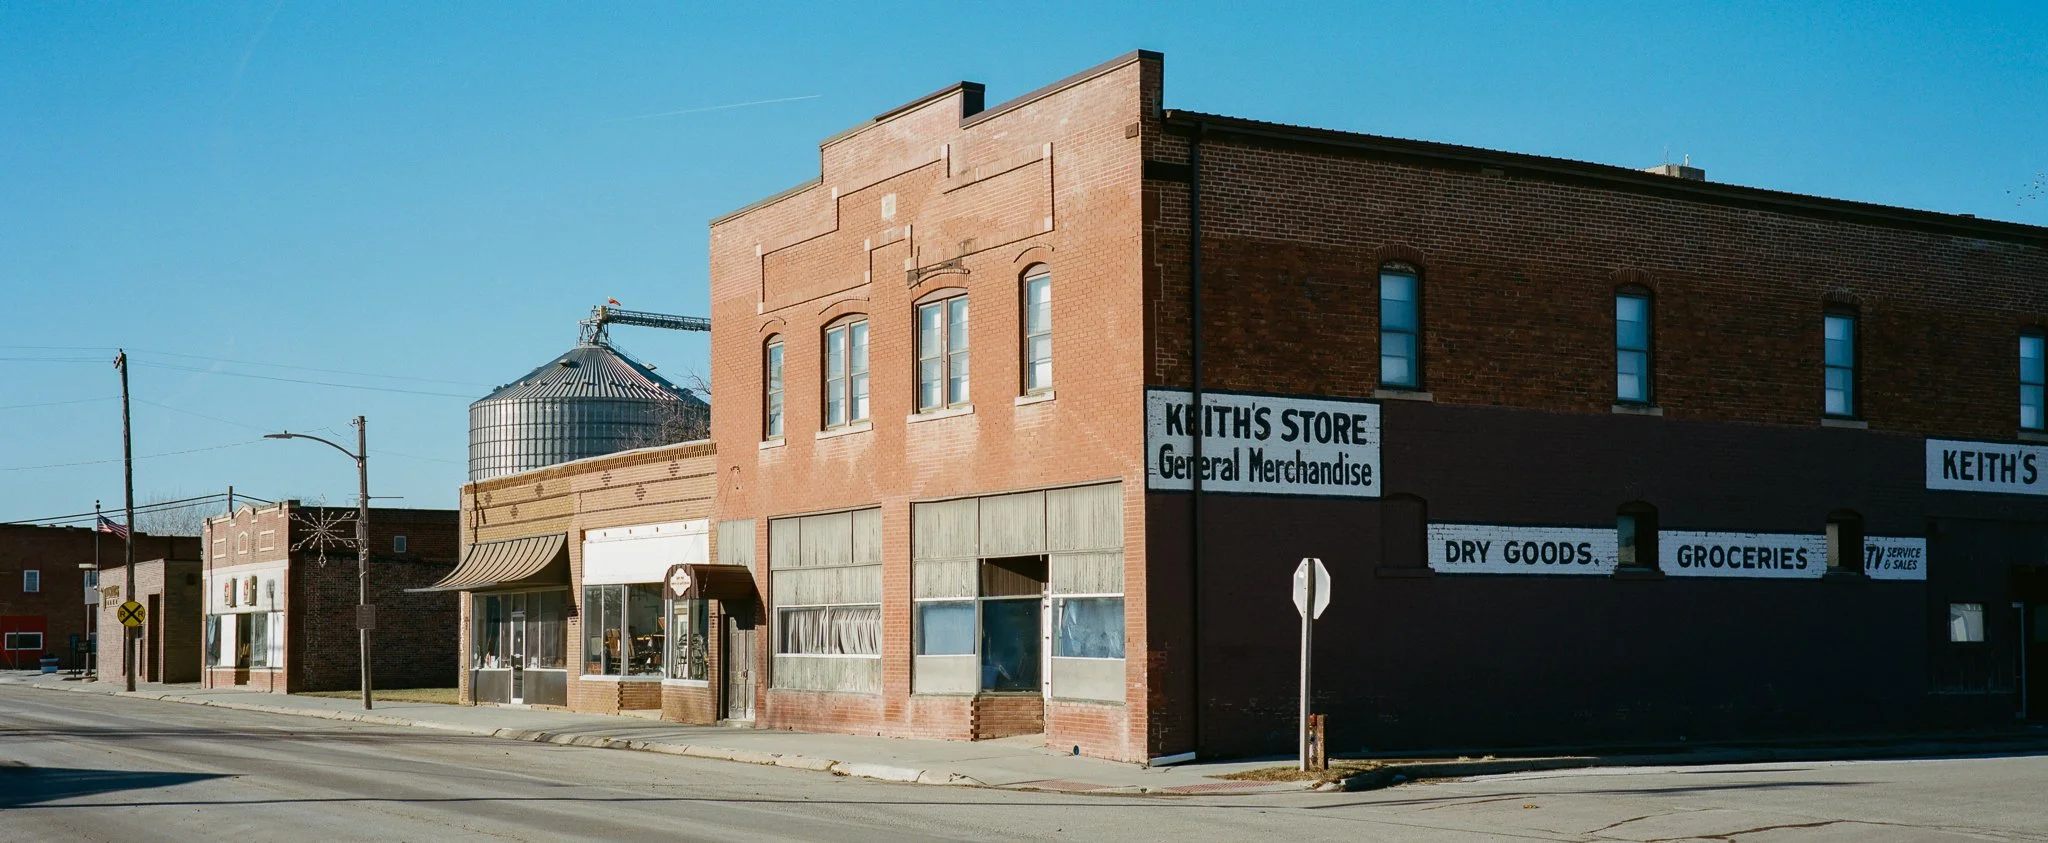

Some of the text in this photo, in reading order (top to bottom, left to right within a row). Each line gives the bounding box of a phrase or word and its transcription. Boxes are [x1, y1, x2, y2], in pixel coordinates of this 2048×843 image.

[1281, 408, 1368, 446] STORE
[1159, 443, 1372, 487] General Merchandise
[1943, 449, 2038, 485] KEITH'S
[1445, 540, 1491, 564] DRY
[1677, 544, 1808, 570] GROCERIES
[1865, 545, 1922, 571] TV SERVICE
[1884, 559, 1918, 571] & SALES
